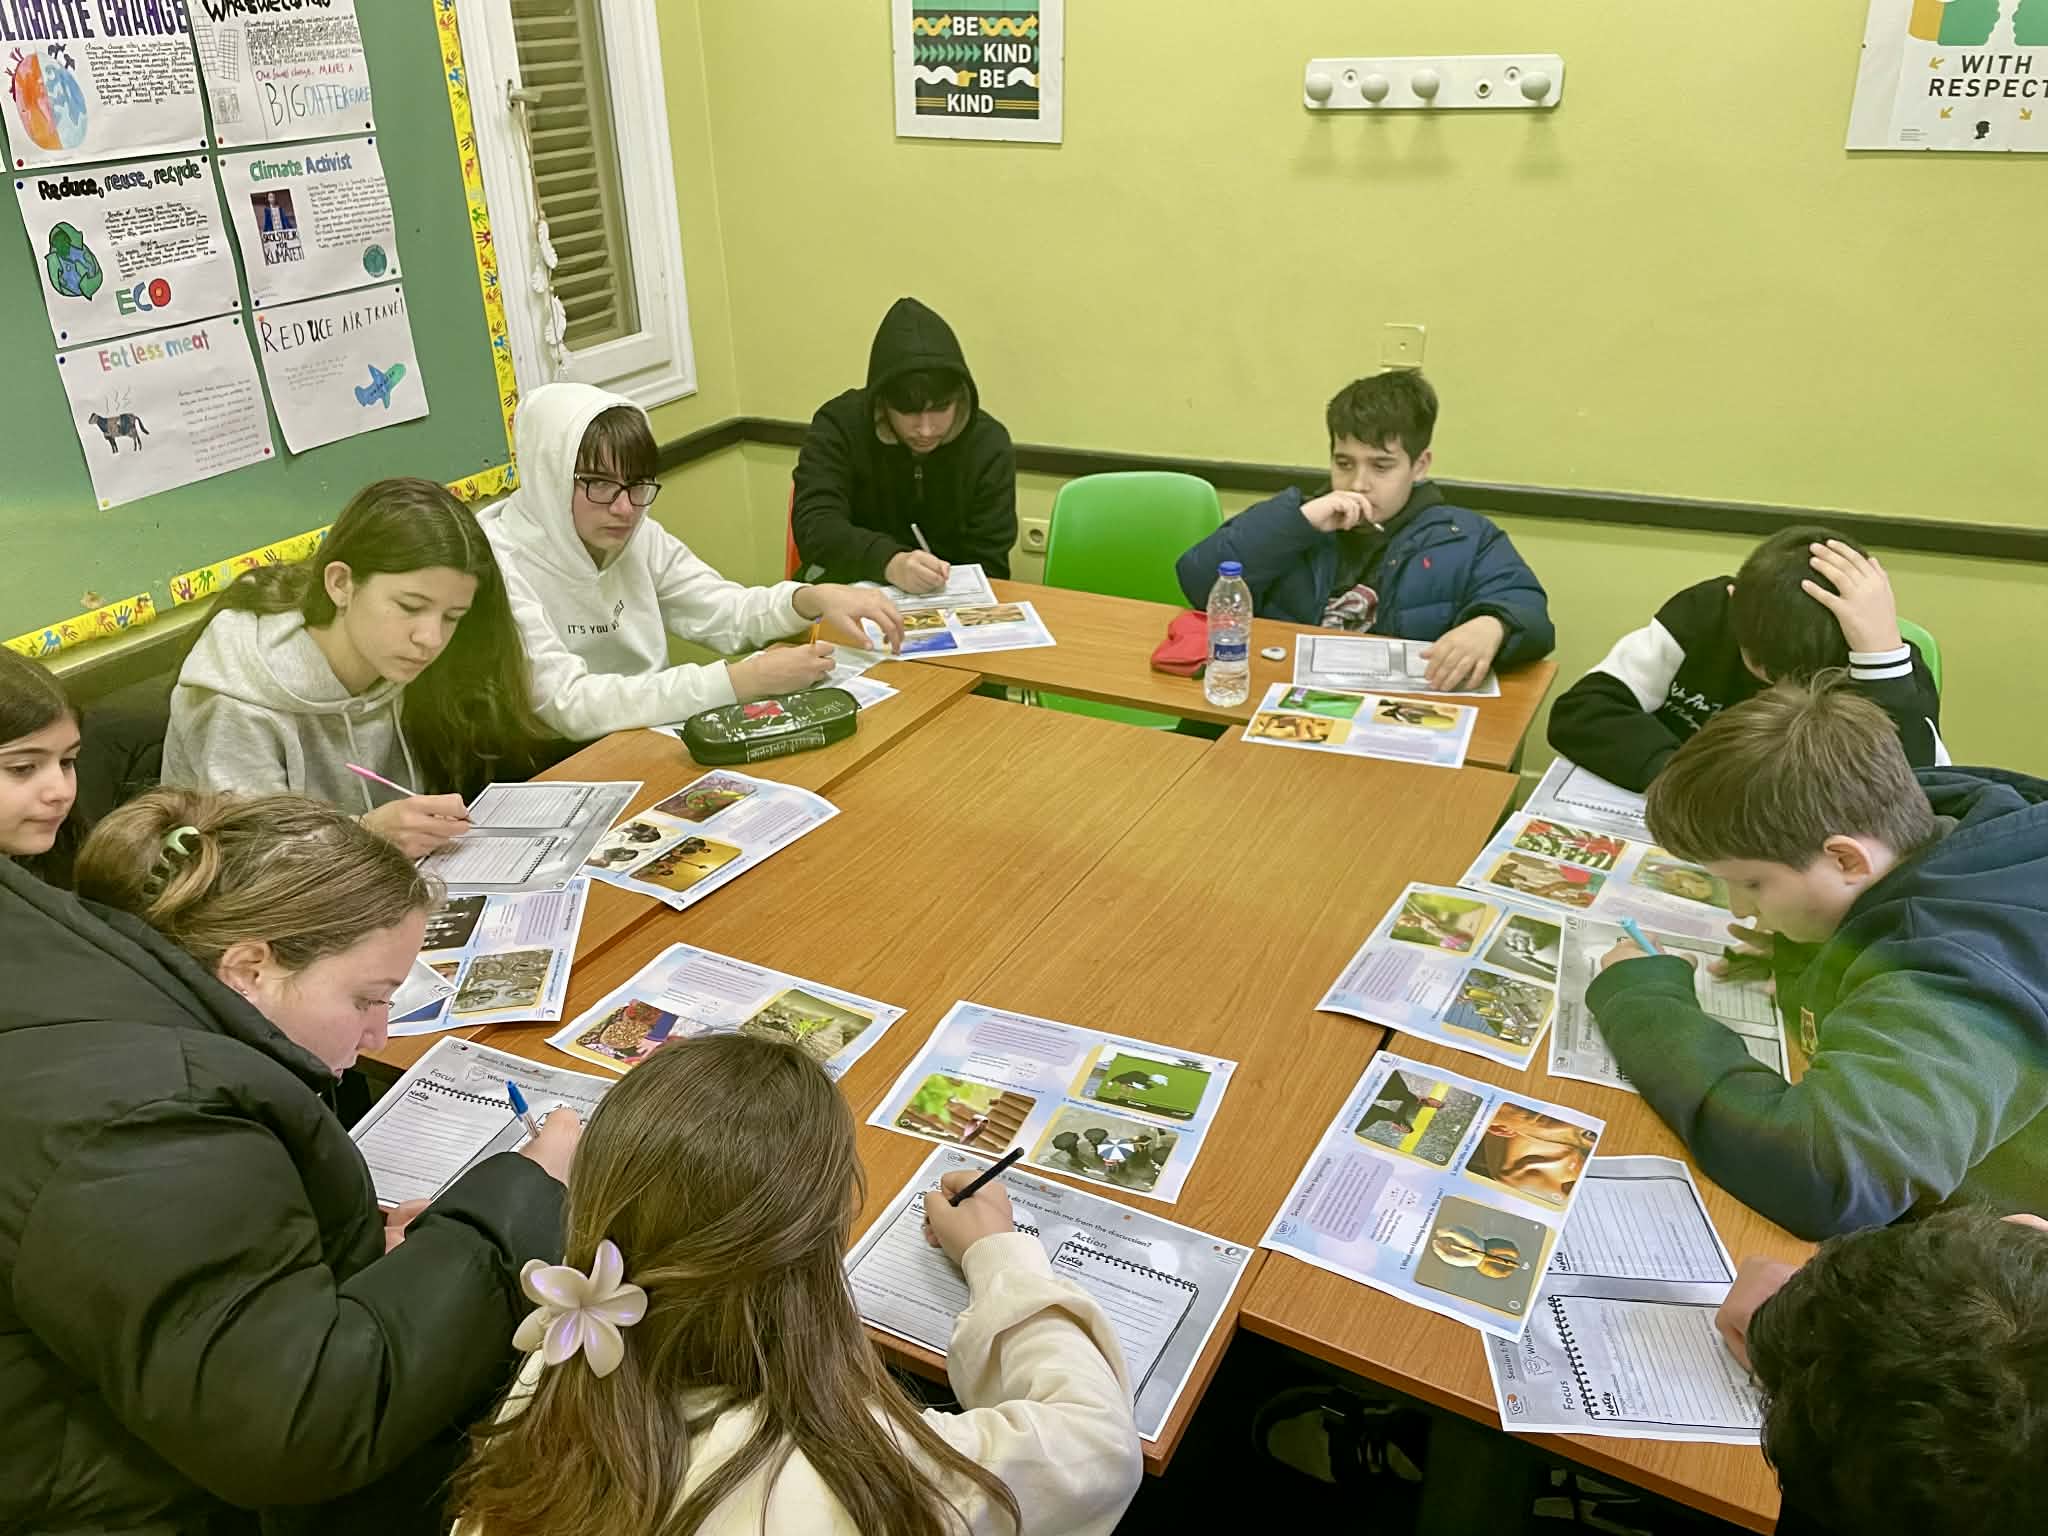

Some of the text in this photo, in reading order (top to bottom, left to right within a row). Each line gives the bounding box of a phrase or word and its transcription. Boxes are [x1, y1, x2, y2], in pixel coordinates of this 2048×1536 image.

[0, 0, 189, 41] LIMATE CHANGE
[953, 16, 979, 36] BE
[983, 43, 1032, 63] KIND
[1961, 55, 2033, 74] WITH
[979, 69, 1006, 88] BE
[265, 83, 306, 126] BIG
[947, 93, 994, 113] KIND
[37, 159, 202, 199] Reduce, reuse, recycle
[250, 152, 353, 182] Climate Activist
[115, 277, 172, 316] ECO
[260, 318, 334, 352] REDUCE
[342, 311, 363, 334] AIR
[98, 330, 211, 372] Eat less meat
[430, 1068, 456, 1082] Focus
[1044, 1206, 1061, 1217] with
[1094, 1223, 1107, 1234] the
[1072, 1231, 1108, 1250] Action
[1525, 1335, 1536, 1354] What
[1504, 1354, 1516, 1381] Session
[1560, 1380, 1576, 1410] Focus
[1602, 1391, 1617, 1416] Notes
